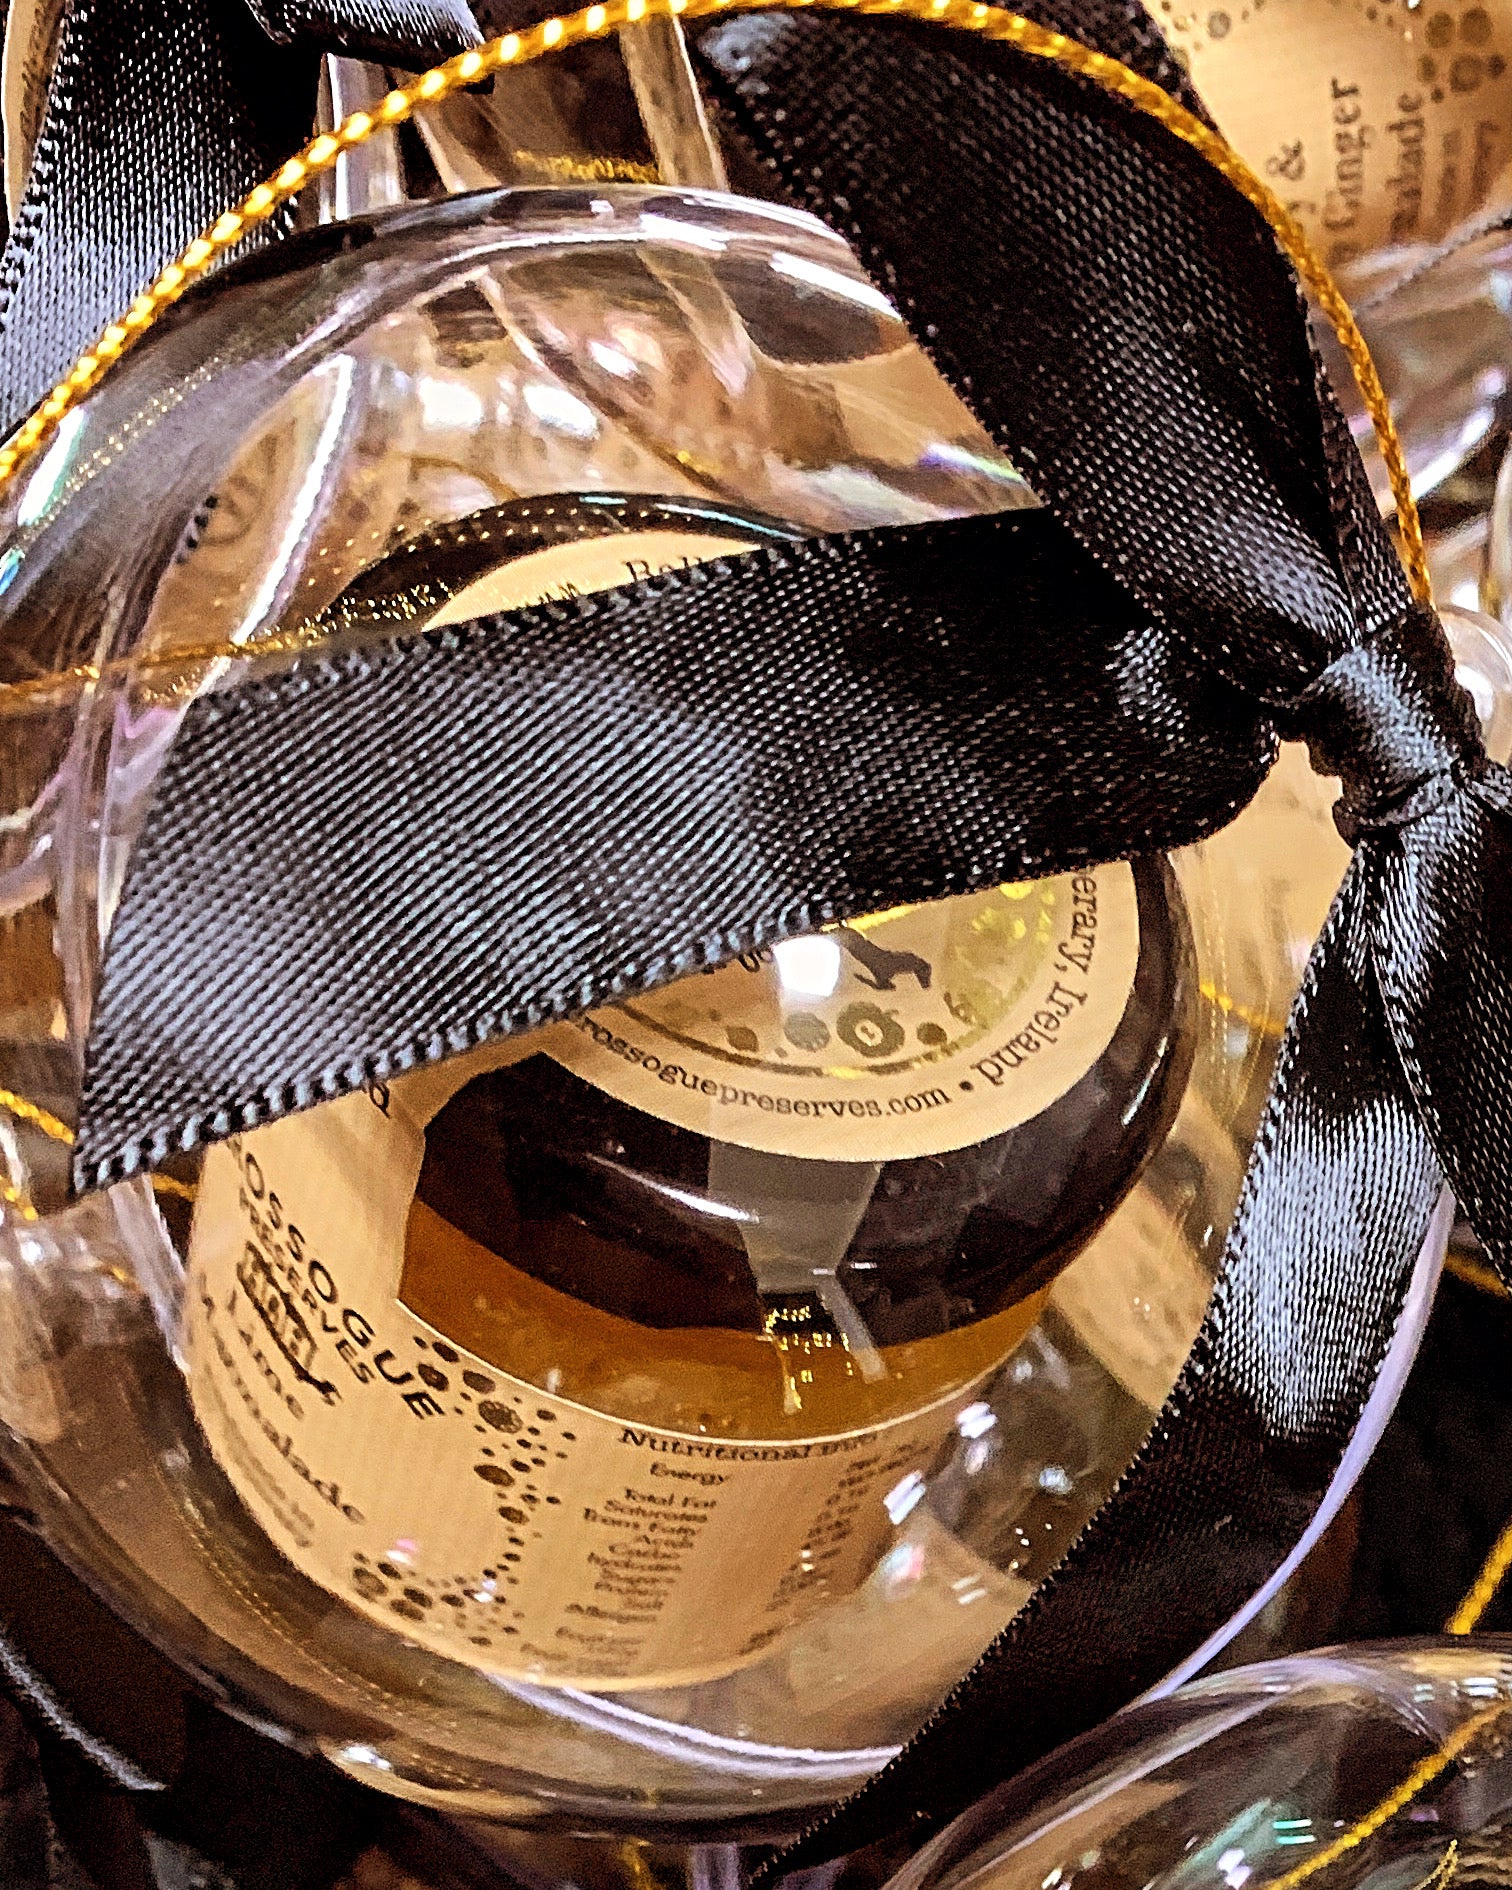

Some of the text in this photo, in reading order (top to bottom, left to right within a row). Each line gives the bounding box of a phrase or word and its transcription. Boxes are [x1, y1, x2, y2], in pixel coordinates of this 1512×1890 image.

[1266, 139, 1306, 182] &
[1323, 77, 1374, 232] Ginger
[973, 868, 1099, 1088] erary, Ireland
[576, 1012, 952, 1120] rossoguepreserves.com
[239, 1186, 377, 1385] PRESERVES
[618, 1428, 811, 1464] Nutritional
[650, 1461, 729, 1487] Energy
